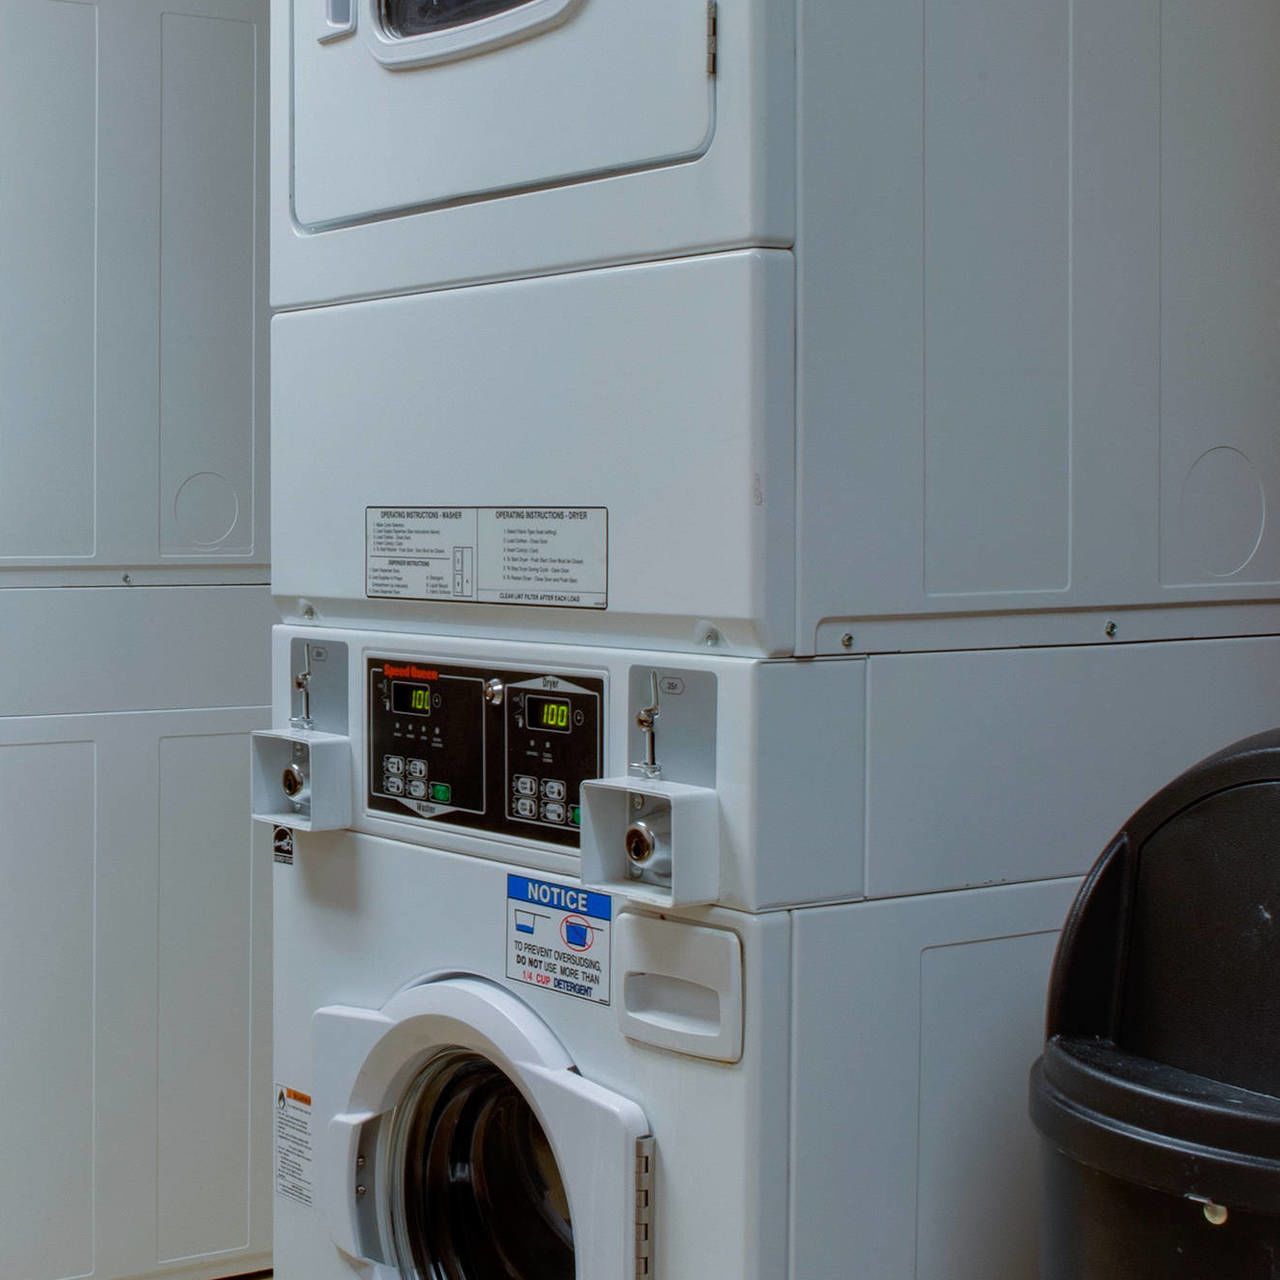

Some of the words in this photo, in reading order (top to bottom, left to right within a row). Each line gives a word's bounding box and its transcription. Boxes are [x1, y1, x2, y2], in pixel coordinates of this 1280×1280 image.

[568, 511, 588, 520] DRYER
[543, 677, 559, 689] Dryer
[544, 704, 568, 727] 100
[528, 882, 588, 911] NOTICE
[514, 940, 523, 951] TO
[524, 942, 553, 958] PREVENT
[516, 954, 526, 966] DO
[527, 957, 543, 969] NOT
[544, 962, 558, 974] USE
[560, 965, 579, 980] MORE
[581, 971, 600, 985] THAN
[522, 969, 533, 981] 1/4
[536, 973, 551, 985] CUP
[553, 977, 593, 998] DETERGENT
